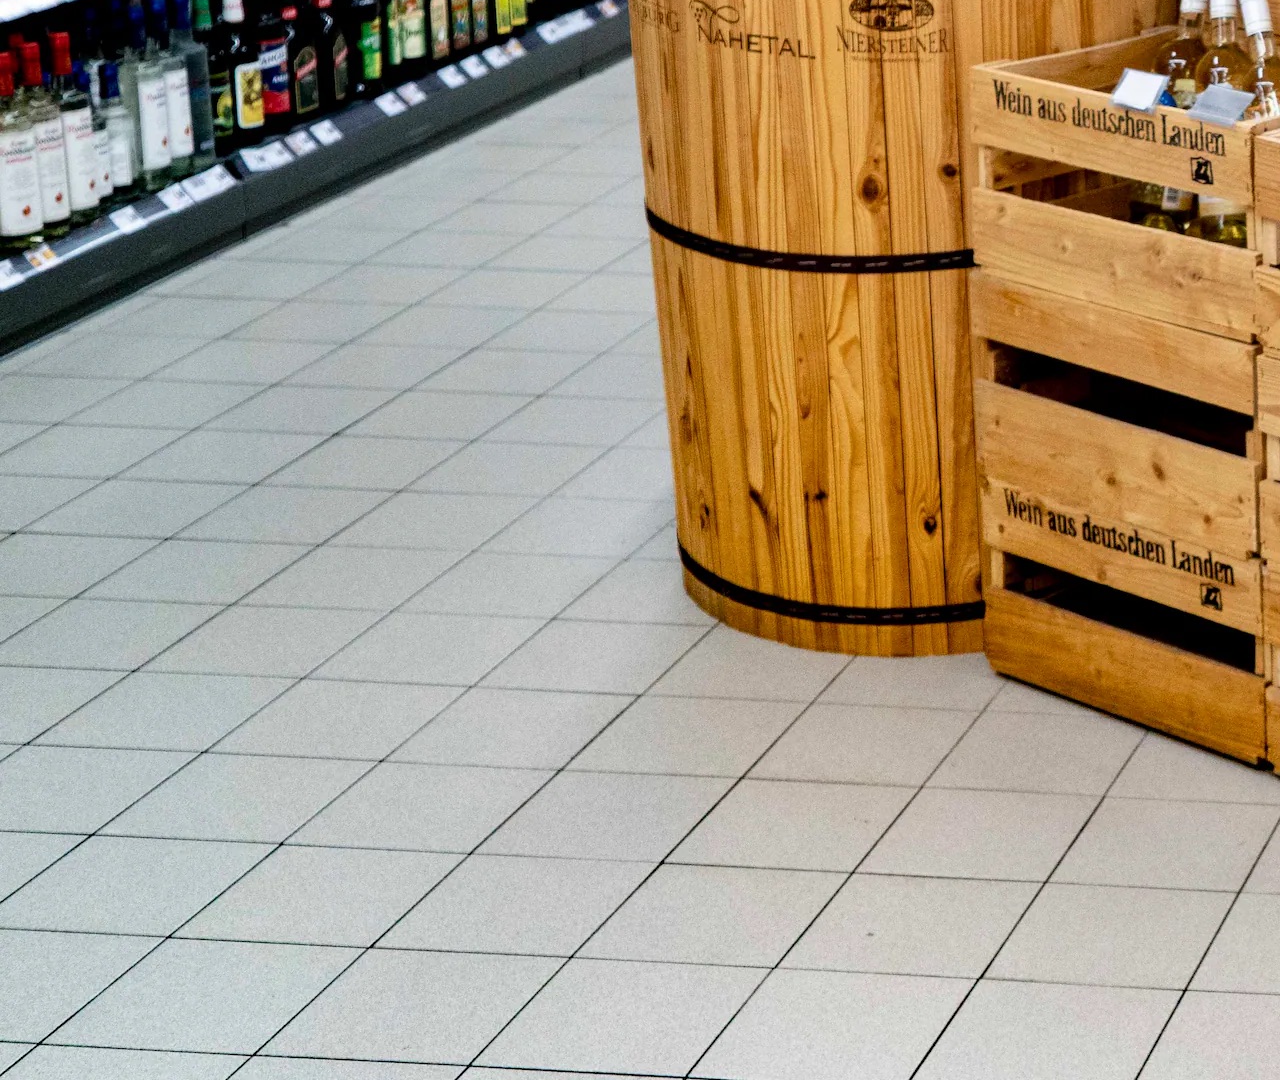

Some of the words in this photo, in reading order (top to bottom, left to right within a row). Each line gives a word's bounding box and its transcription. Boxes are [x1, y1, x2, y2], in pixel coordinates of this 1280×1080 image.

[697, 18, 816, 61] NAHETAL
[836, 24, 951, 54] NIERSTEINER
[992, 78, 1034, 117] Wein
[1036, 95, 1068, 124] aus
[1071, 99, 1156, 145] deutschen
[1160, 115, 1227, 157] Landen
[1003, 486, 1045, 528] Wein
[1047, 505, 1079, 539] aus
[1081, 514, 1166, 567] deutschen
[1170, 540, 1236, 586] Landen
